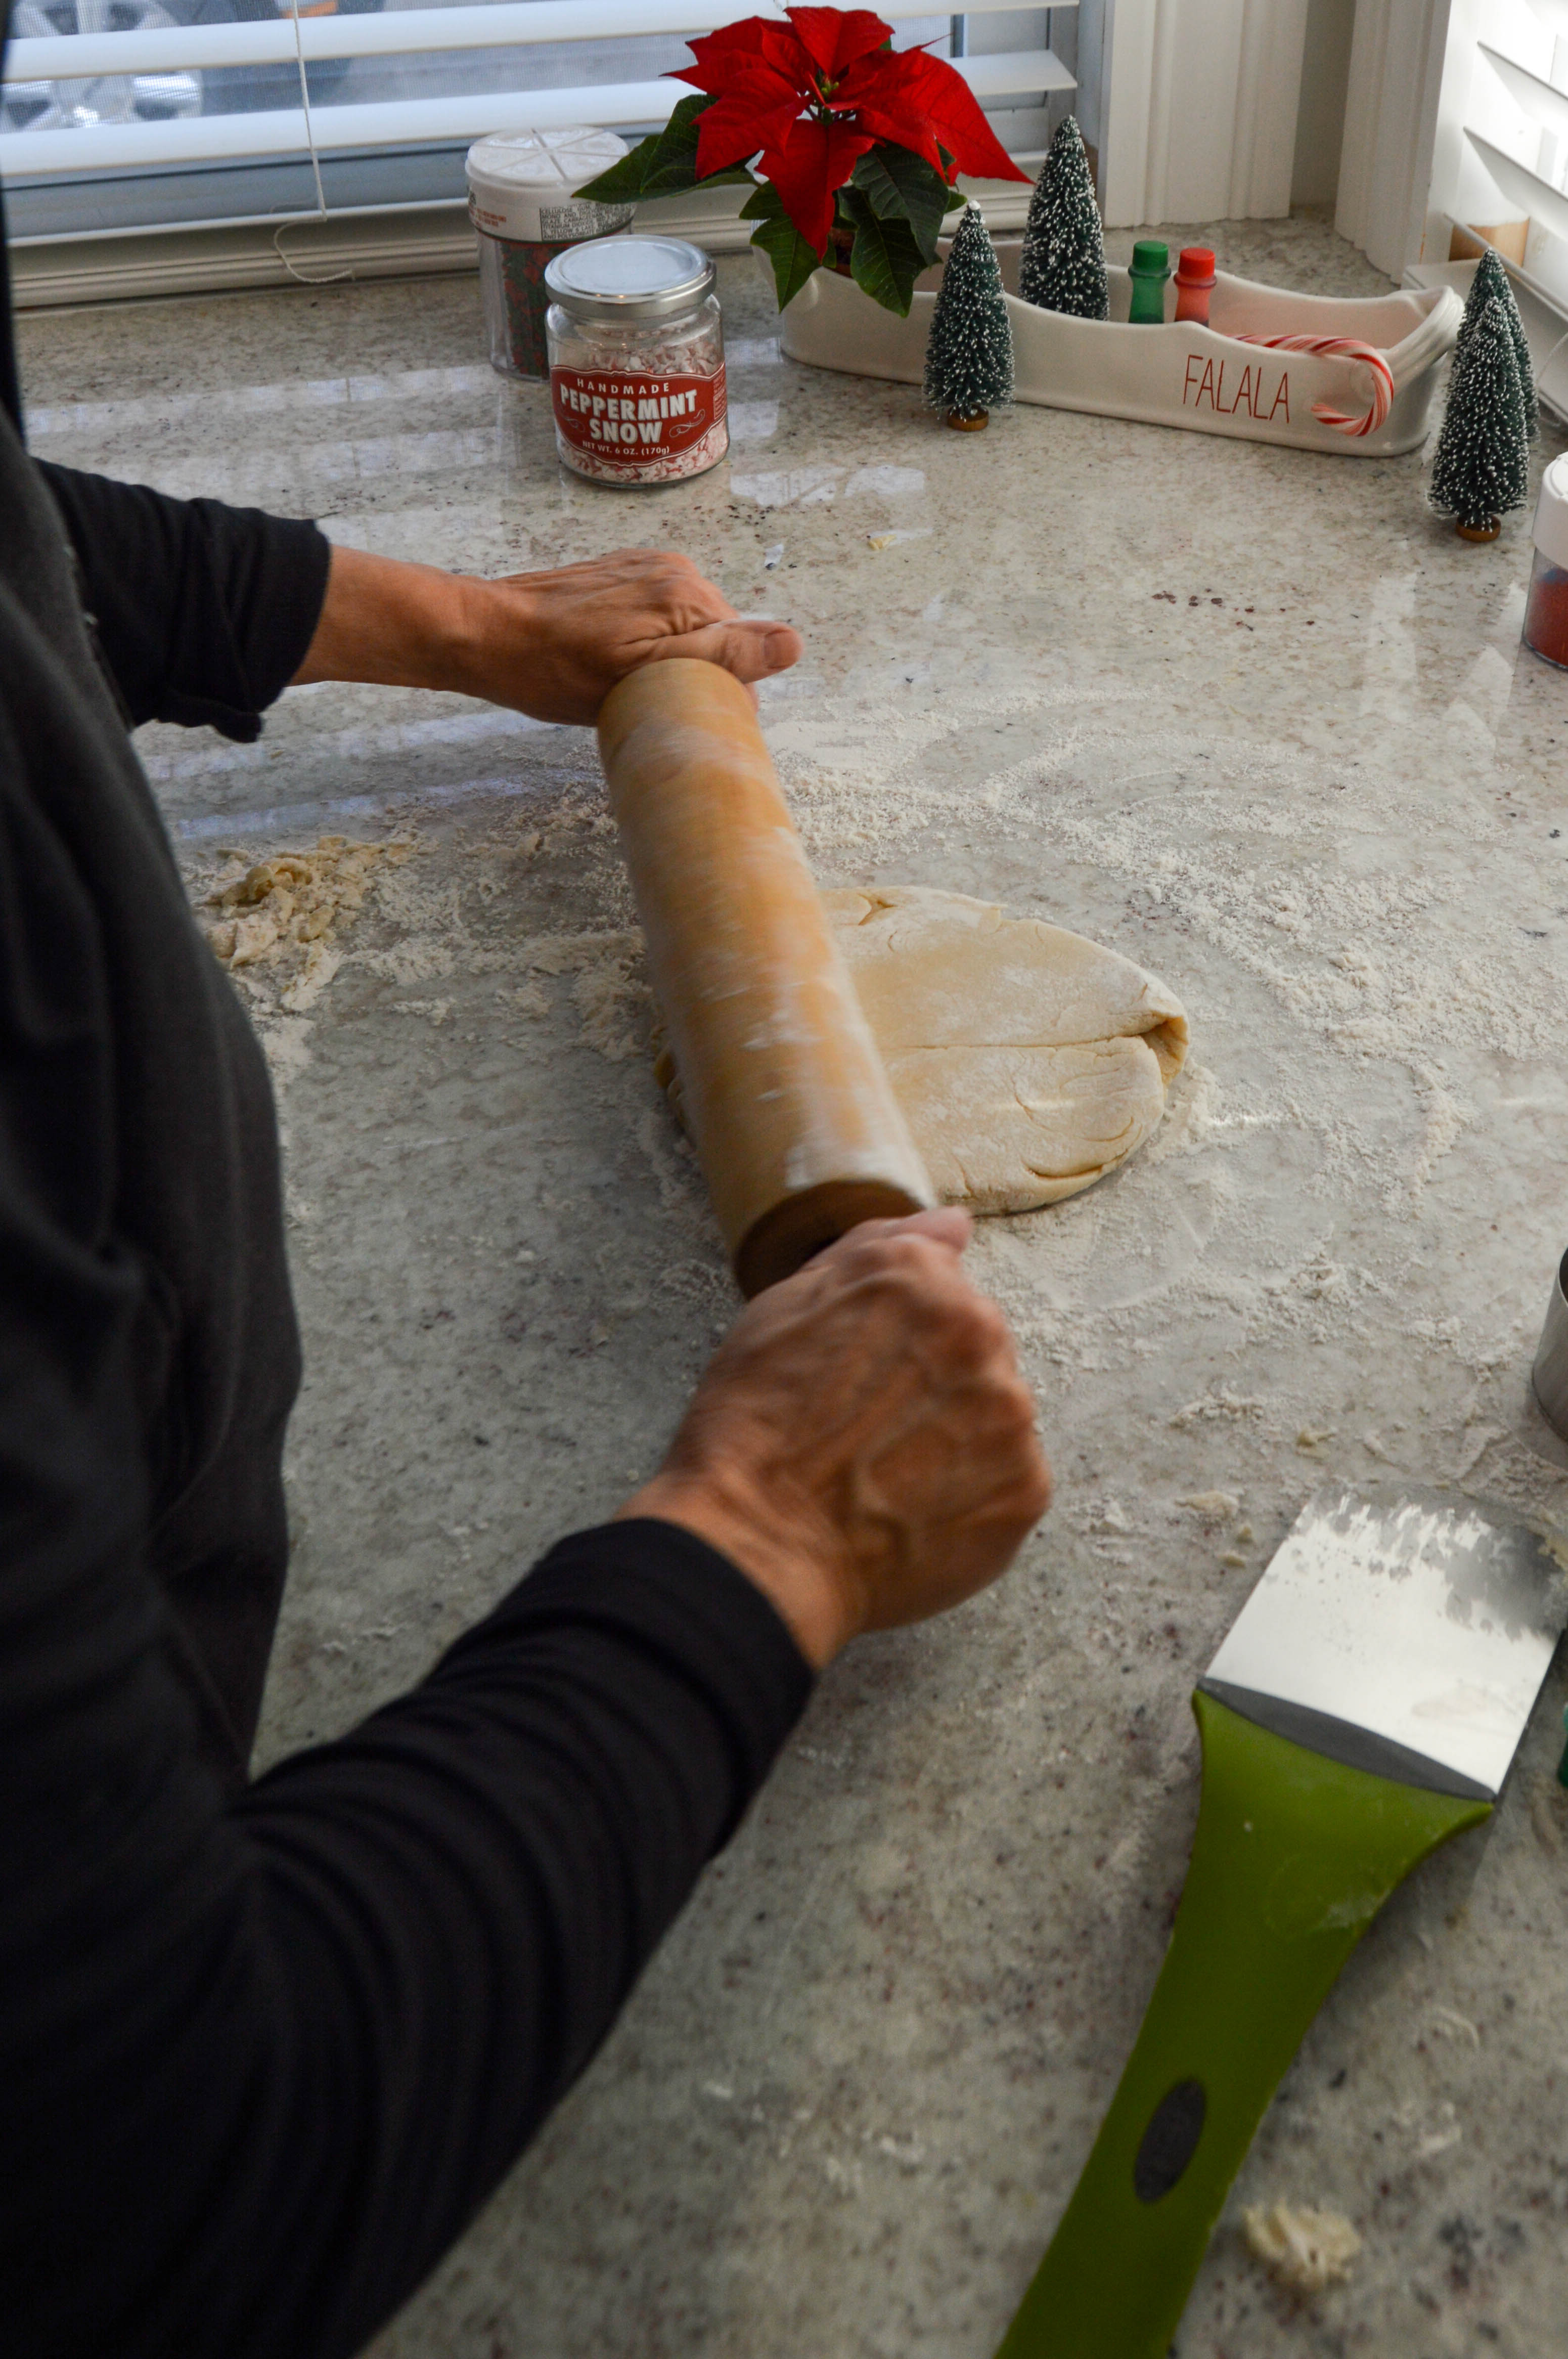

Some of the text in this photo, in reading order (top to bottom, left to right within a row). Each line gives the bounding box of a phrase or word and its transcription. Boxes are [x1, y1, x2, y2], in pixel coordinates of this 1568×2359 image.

[577, 378, 669, 395] HANDMADE
[560, 384, 697, 421] PEPPERMINT
[590, 418, 662, 444] SNOW
[582, 441, 595, 449] NET
[598, 445, 612, 453] WT.
[641, 446, 669, 456] (170g)
